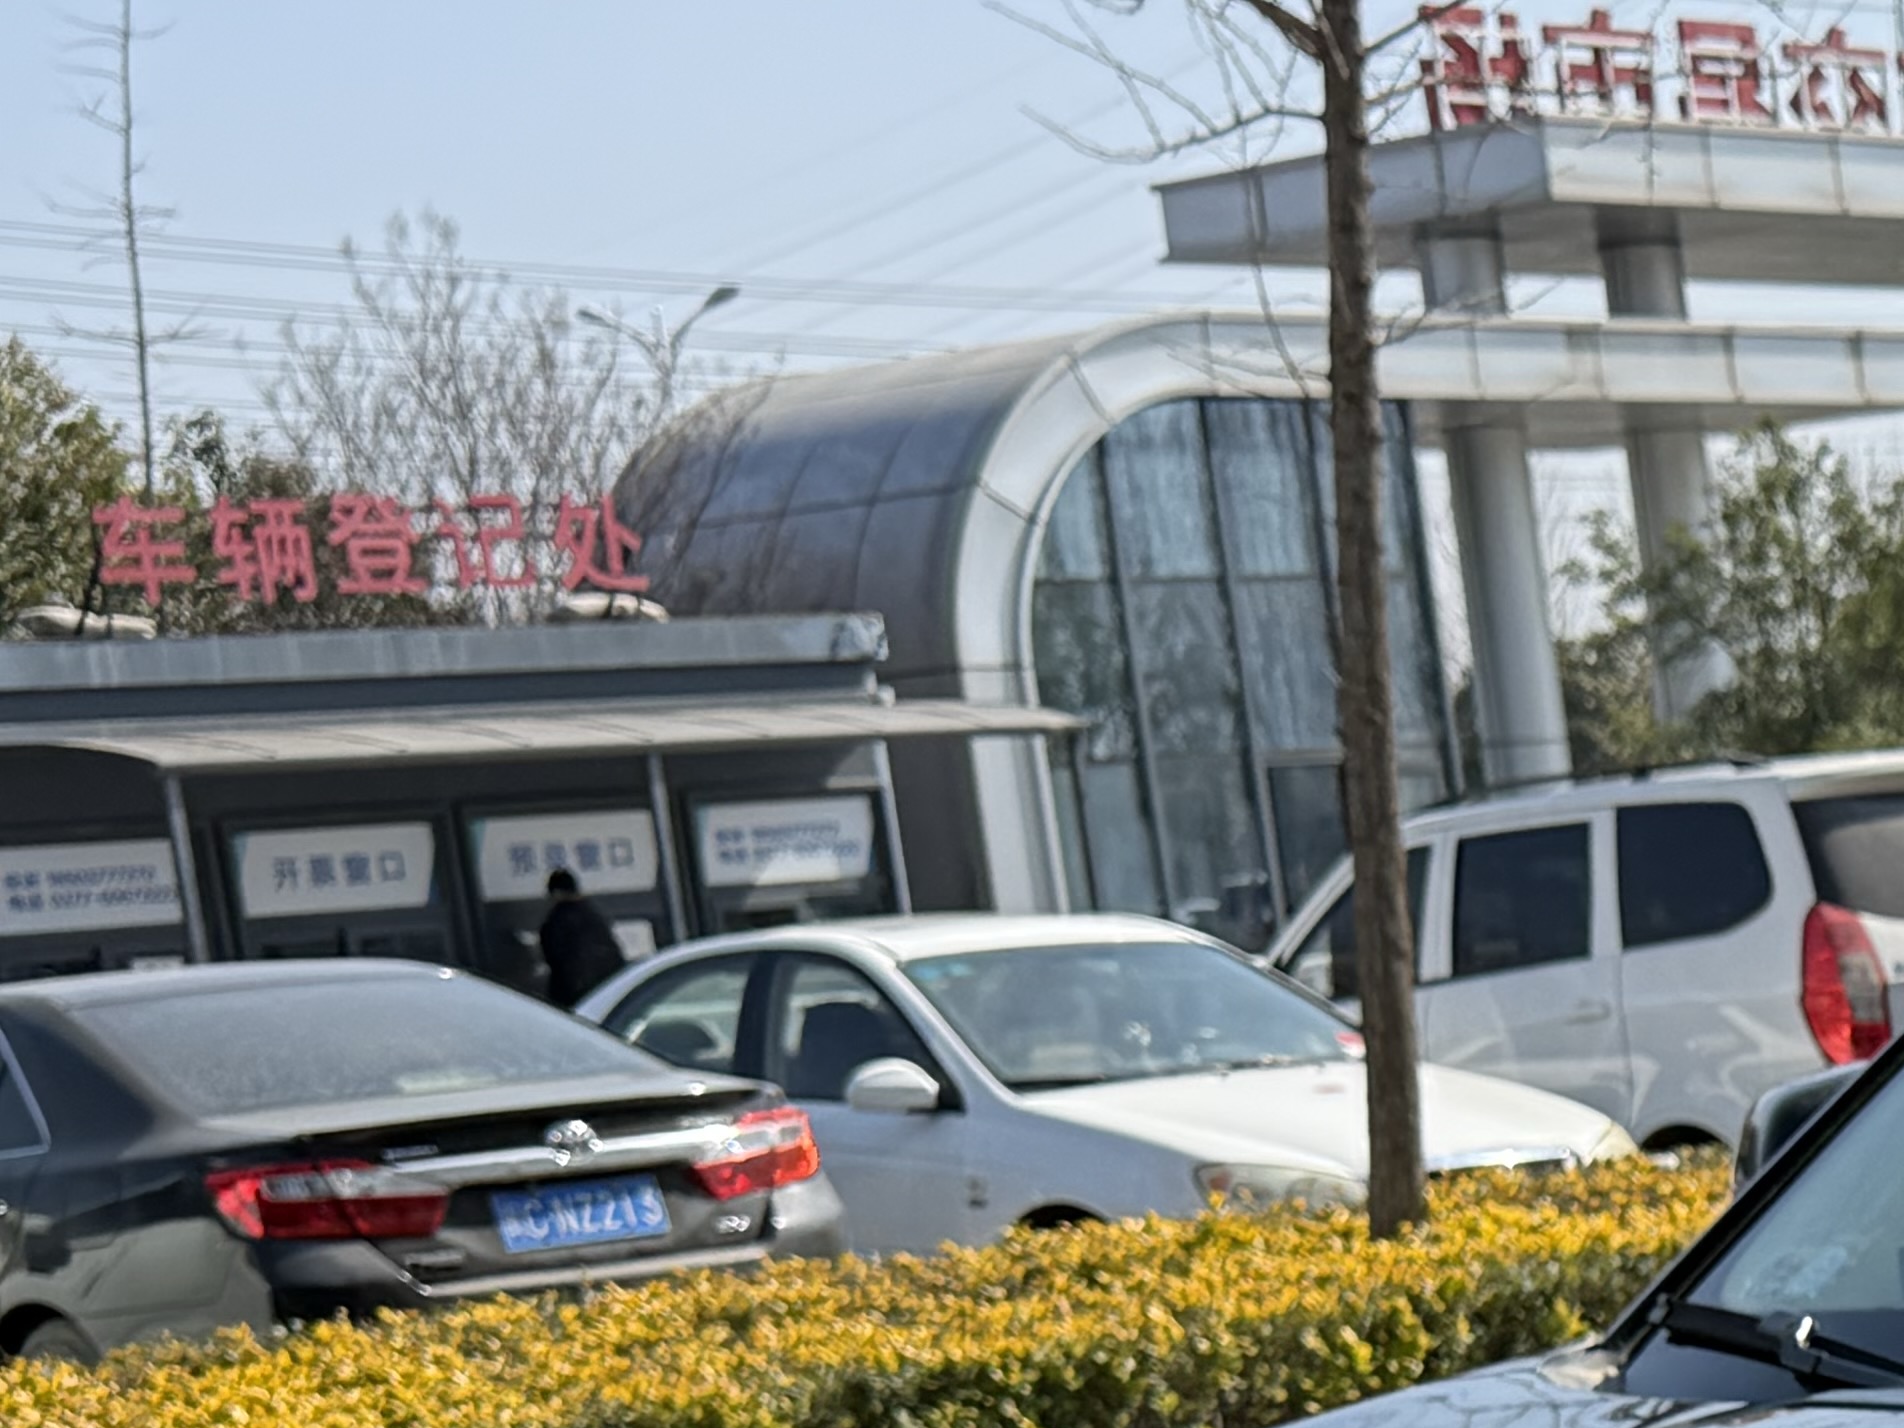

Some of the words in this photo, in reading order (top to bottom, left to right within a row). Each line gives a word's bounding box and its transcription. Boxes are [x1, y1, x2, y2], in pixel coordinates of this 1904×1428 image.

[91, 492, 649, 604] 车辆登记处
